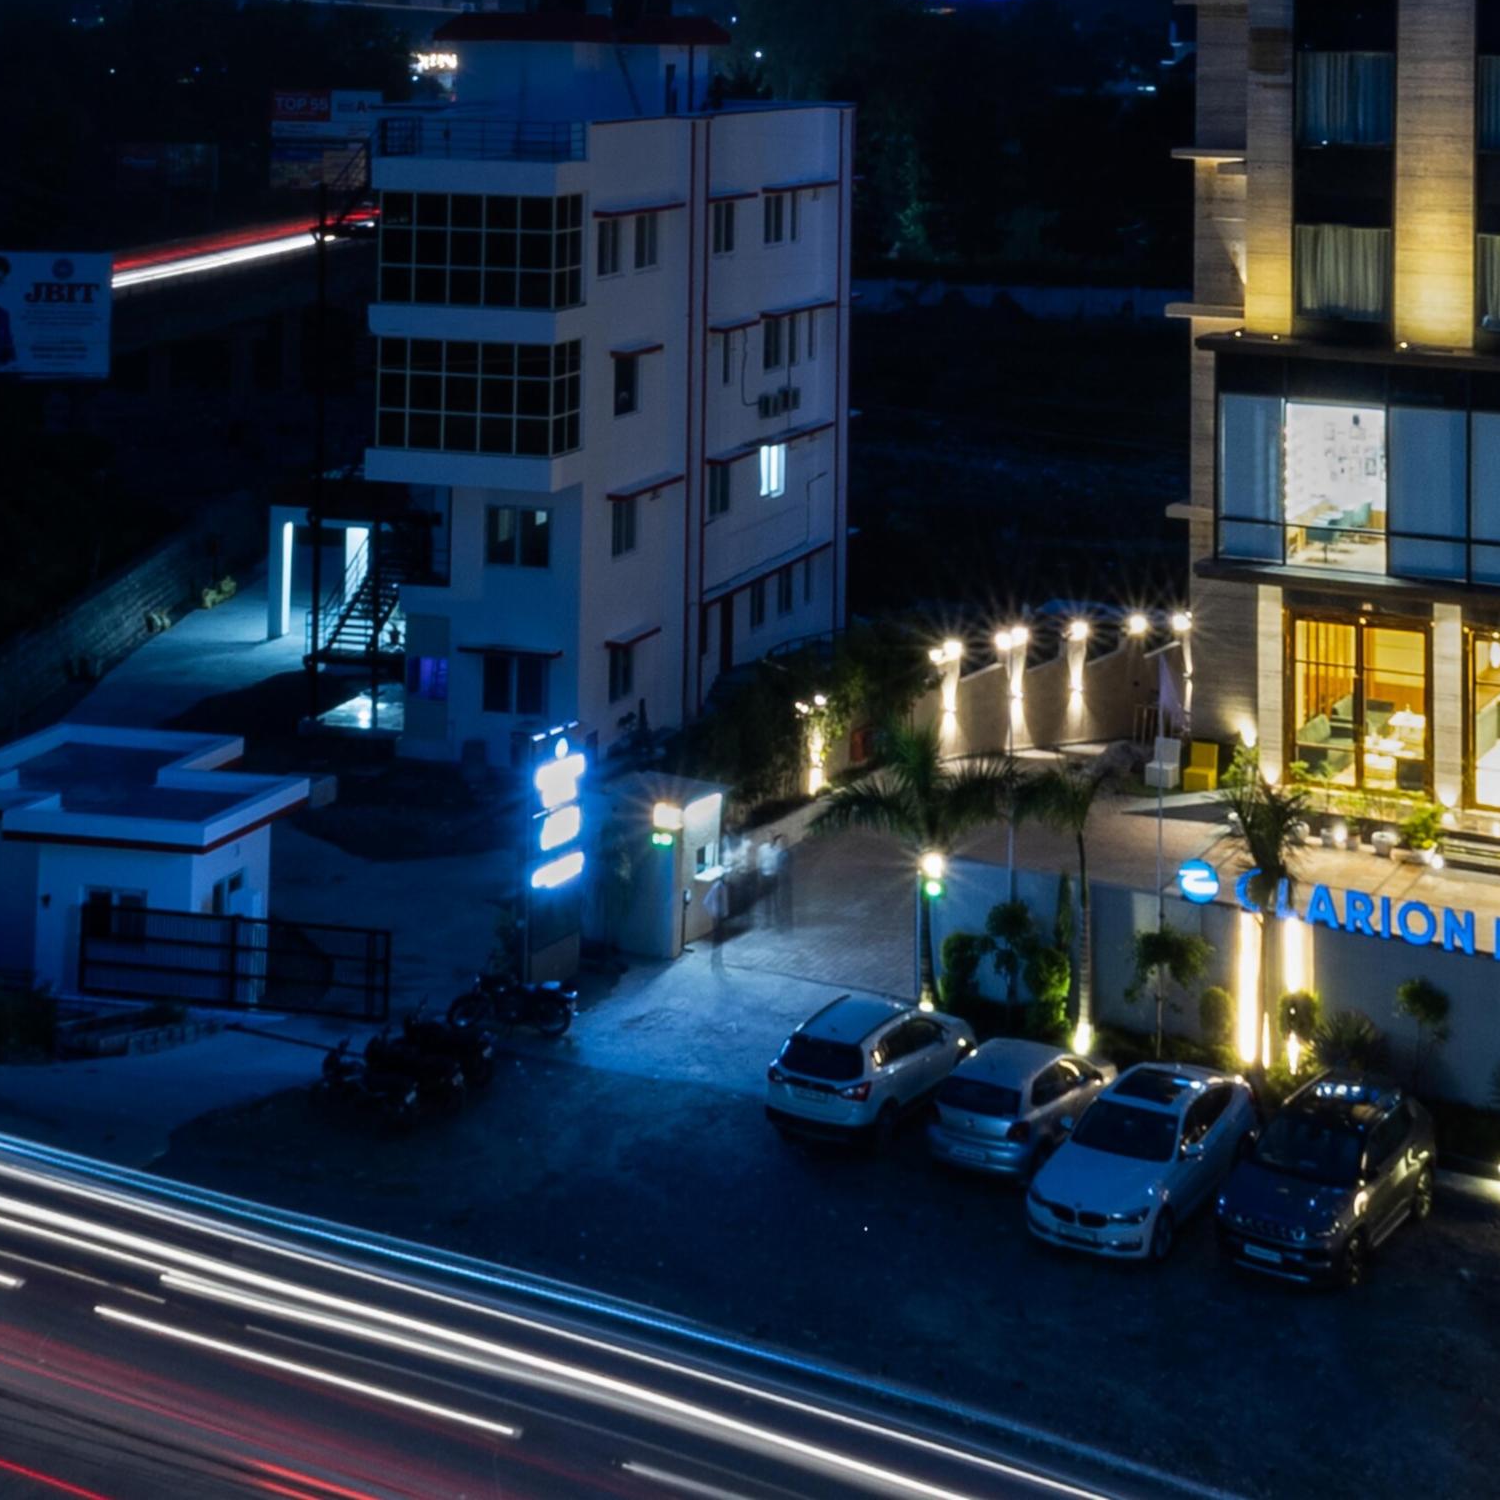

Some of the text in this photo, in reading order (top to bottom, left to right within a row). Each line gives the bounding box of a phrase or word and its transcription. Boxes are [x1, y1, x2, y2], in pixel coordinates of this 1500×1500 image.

[275, 97, 307, 110] TOP
[24, 282, 101, 304] JBIT
[1235, 867, 1476, 956] CLARION
